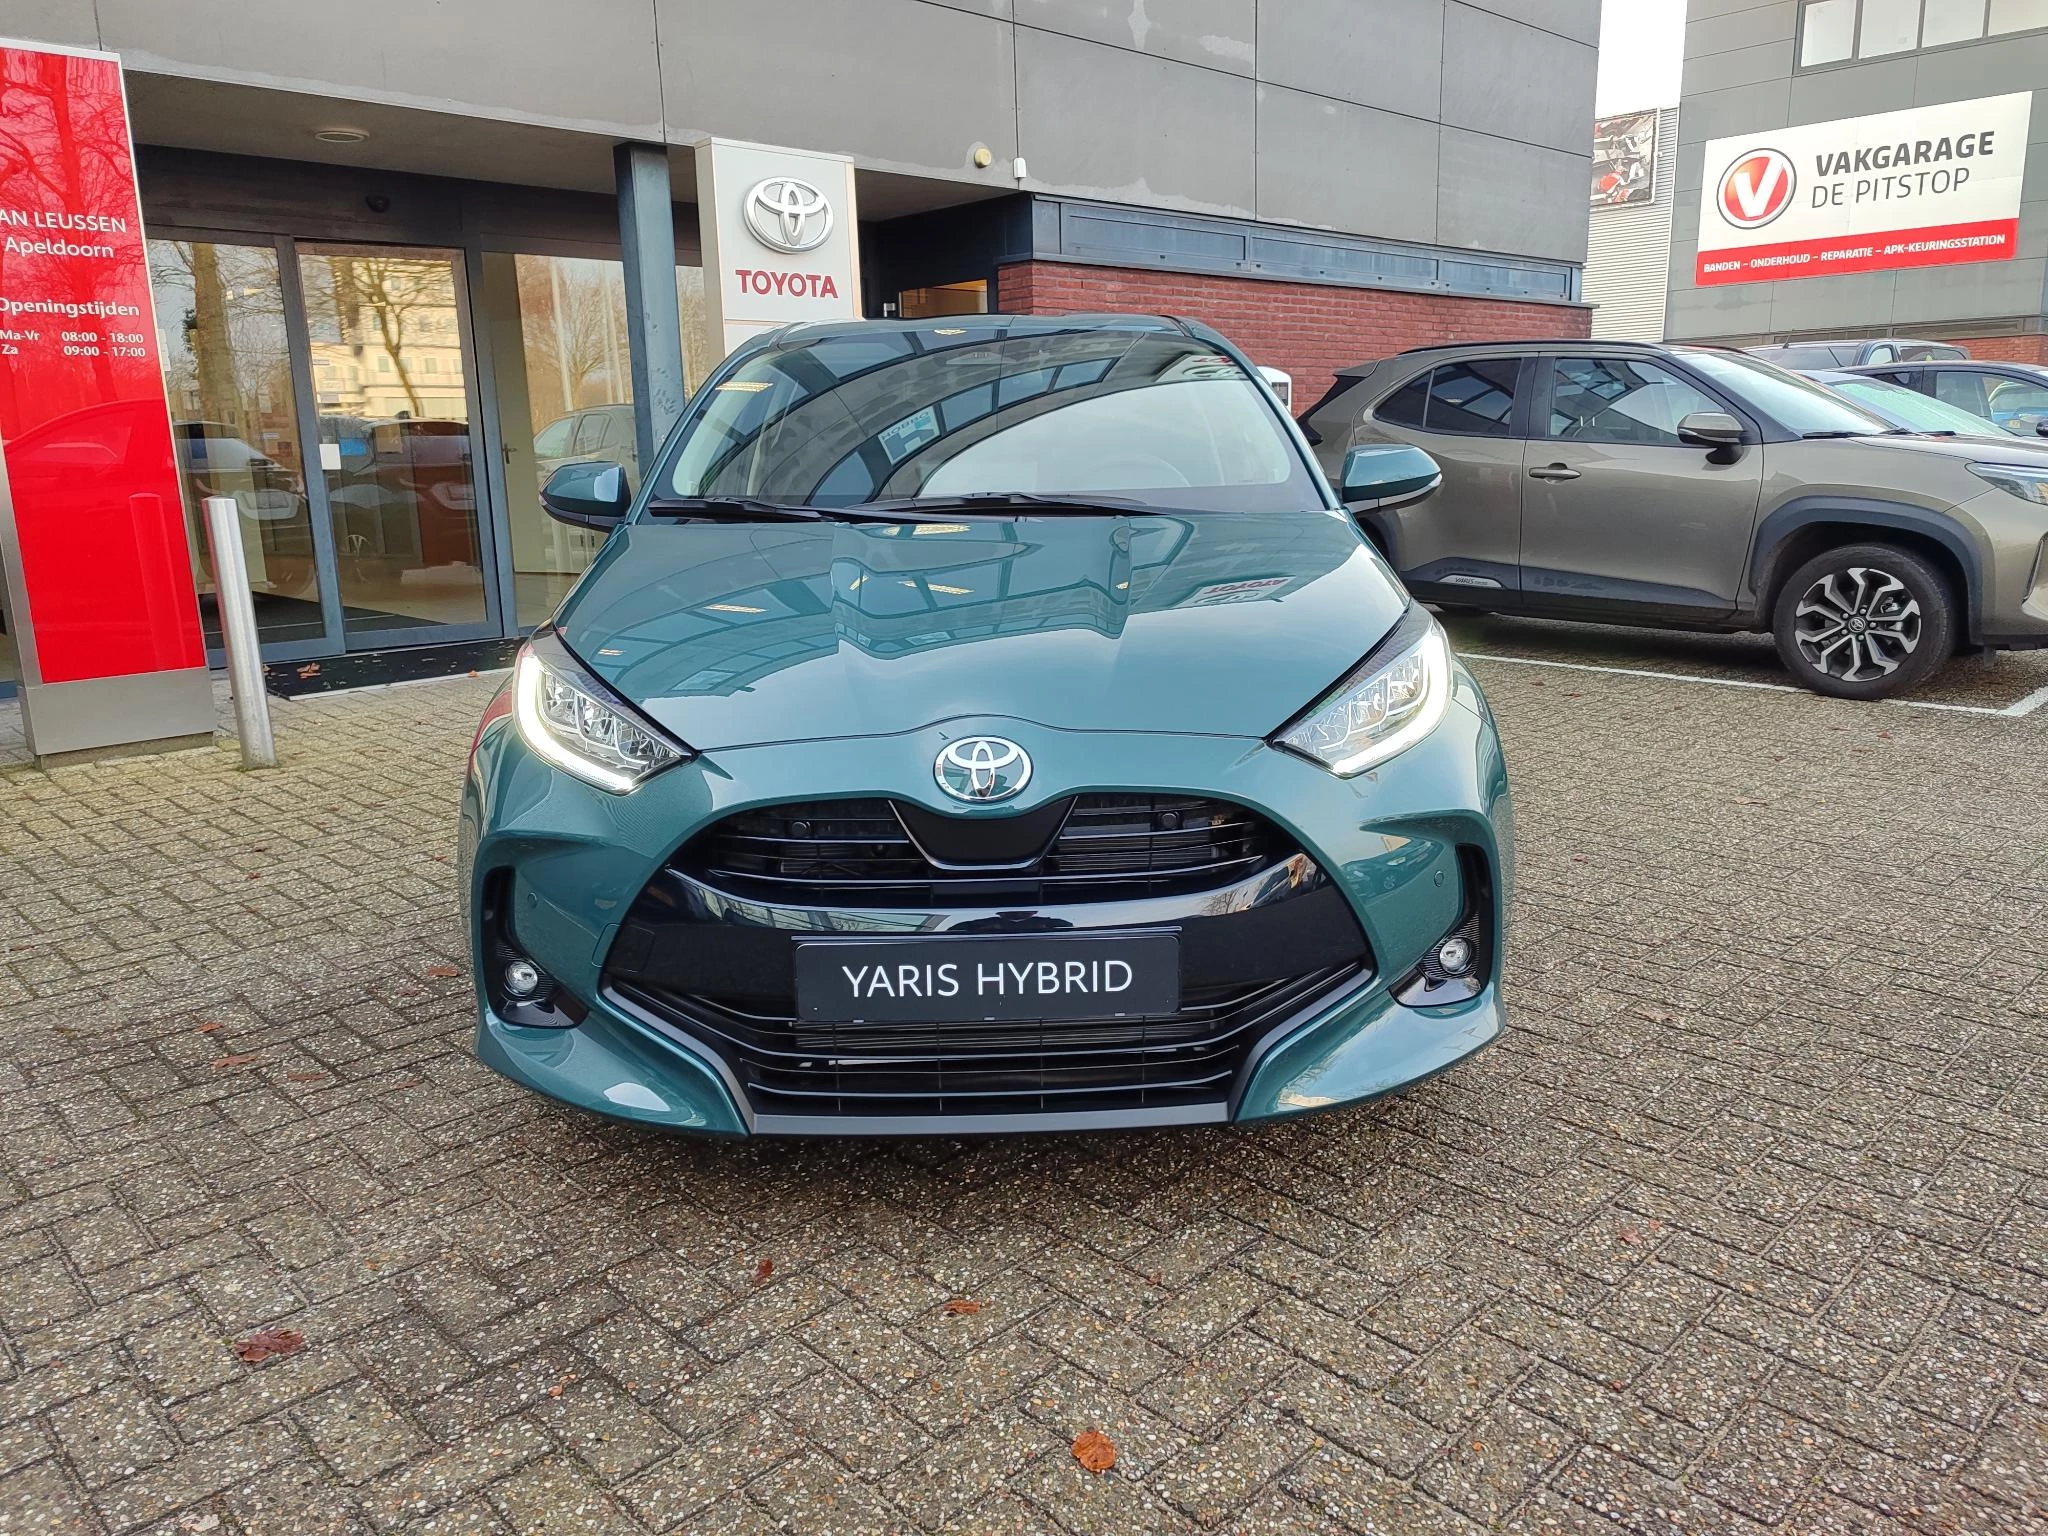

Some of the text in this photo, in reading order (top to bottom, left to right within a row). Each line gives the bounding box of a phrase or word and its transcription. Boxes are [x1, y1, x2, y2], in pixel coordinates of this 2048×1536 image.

[1816, 131, 1995, 177] VAKGARAGE
[1812, 167, 1970, 209] DE PITSTOP
[34, 211, 126, 233] LEUSSEN
[5, 236, 114, 258] Apeldoorn
[1703, 260, 1741, 273] BANDEN
[1750, 252, 1811, 269] ONDERHOUD
[1820, 246, 1874, 262] REPARATIE
[1884, 233, 2006, 255] APK-KEURINGSSTATION
[735, 269, 839, 299] TOYOTA
[0, 297, 139, 318] Openingstijden
[0, 330, 41, 341] Ma-Vr
[61, 331, 98, 343] 08:00
[110, 332, 144, 344] 18:00
[1, 344, 19, 355] Za
[63, 345, 100, 357] 09:00
[112, 346, 146, 357] 17:00
[1455, 576, 1474, 584] YARIS
[842, 959, 1134, 998] YARIS HYBRID
